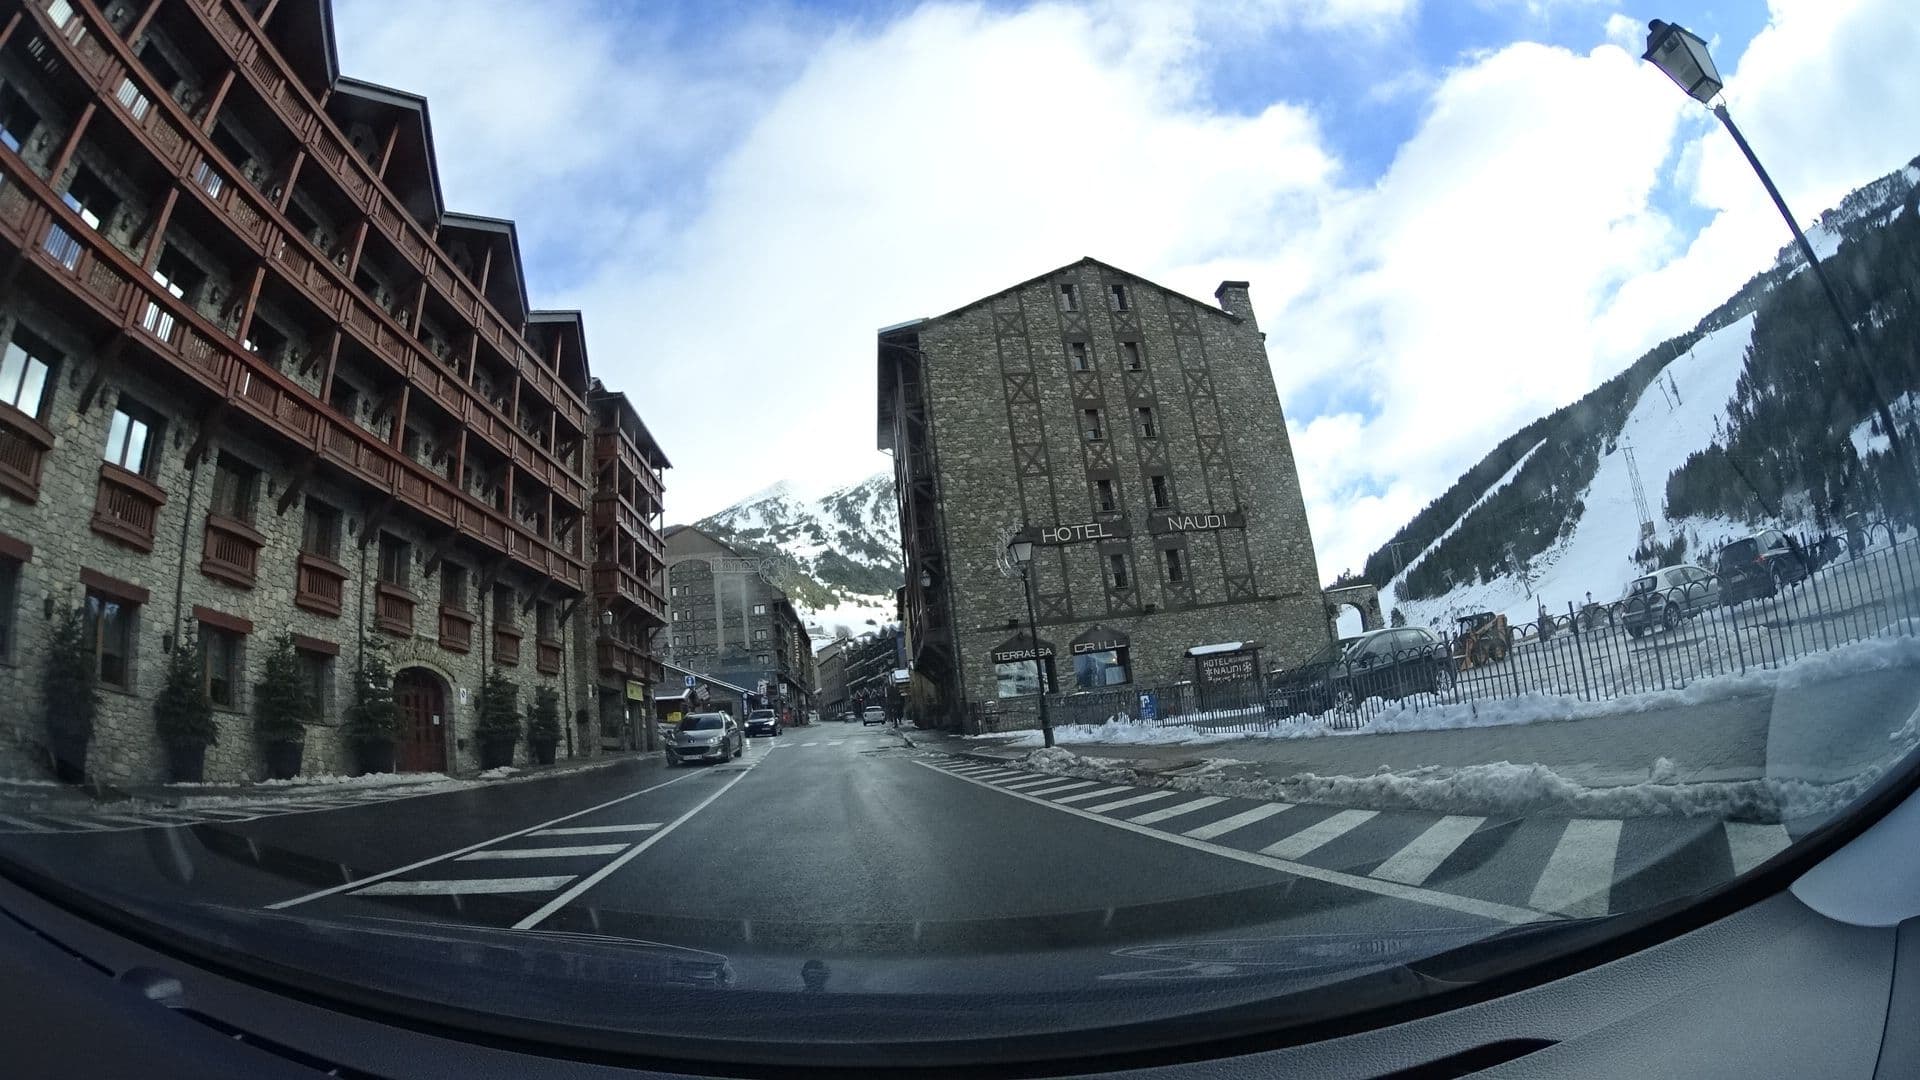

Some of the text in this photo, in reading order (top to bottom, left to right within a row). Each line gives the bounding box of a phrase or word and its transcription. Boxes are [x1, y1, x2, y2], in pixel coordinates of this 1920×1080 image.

[1042, 514, 1227, 543] HOTEL NAUDI
[1074, 640, 1126, 653] GRILL
[995, 647, 1053, 661] TERRASSA
[1203, 657, 1229, 668] HOTEL
